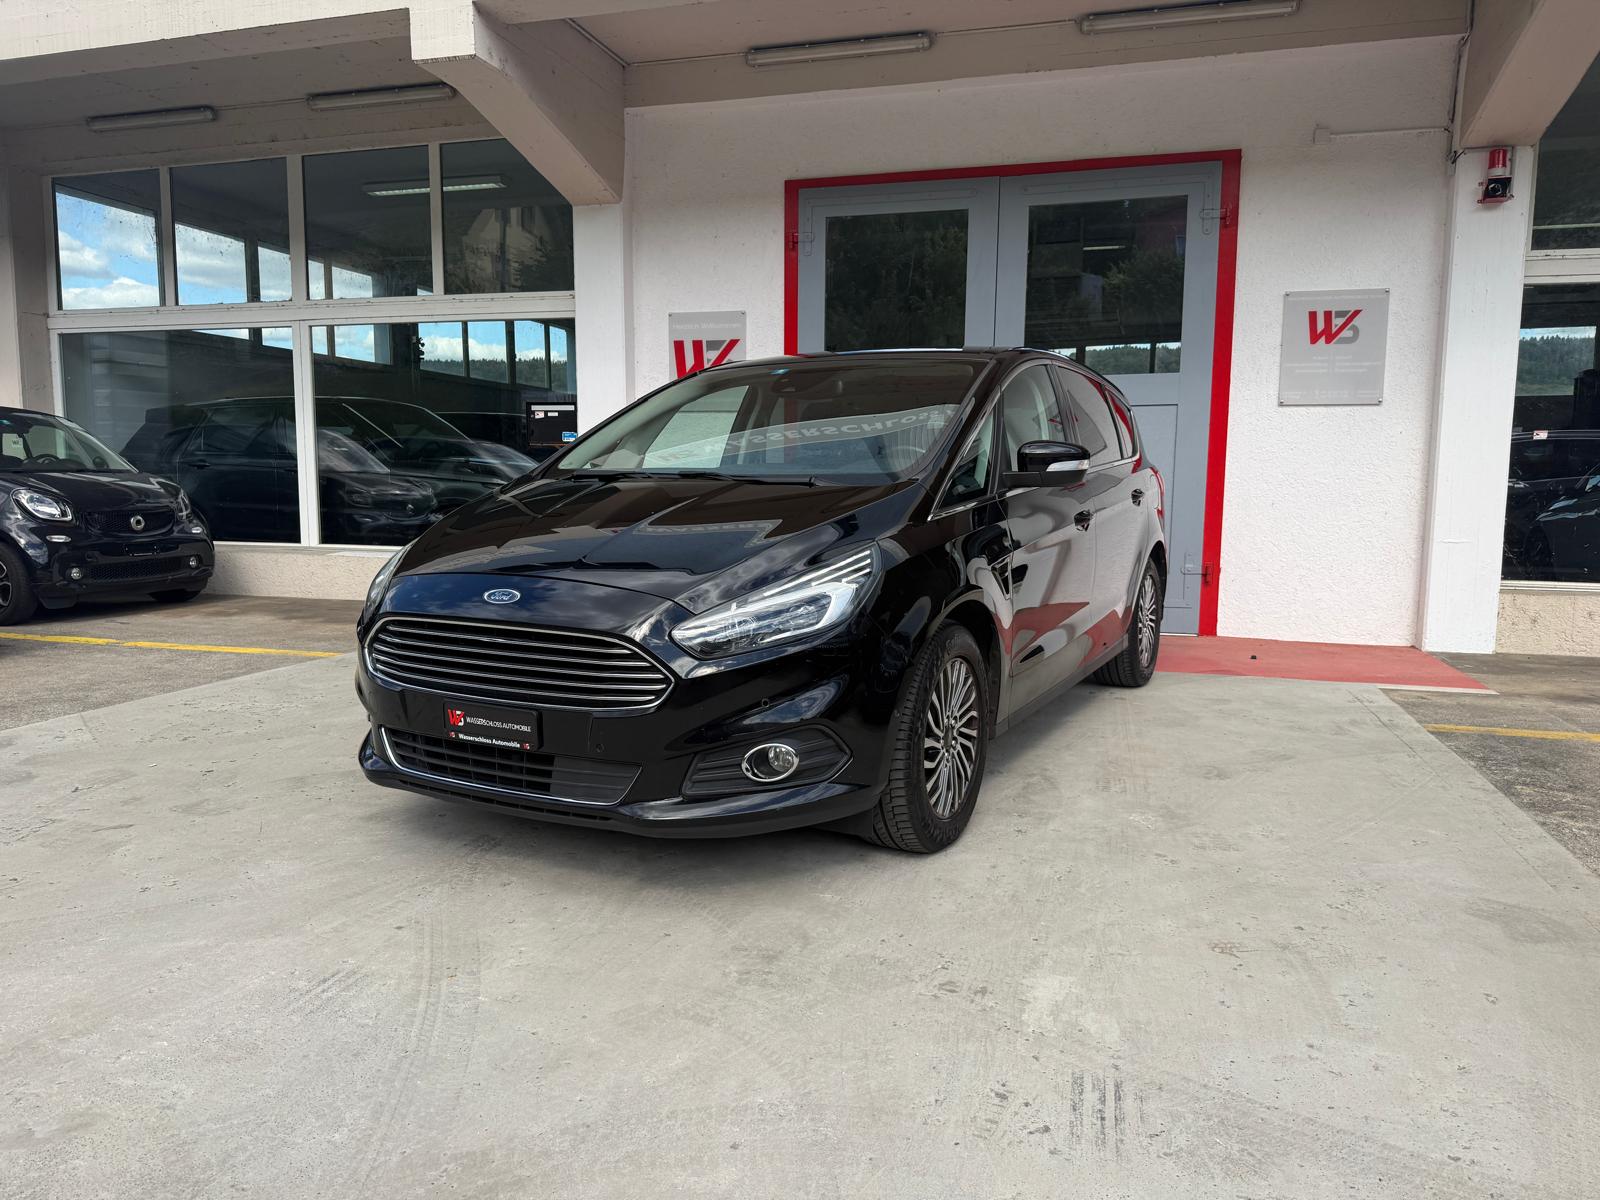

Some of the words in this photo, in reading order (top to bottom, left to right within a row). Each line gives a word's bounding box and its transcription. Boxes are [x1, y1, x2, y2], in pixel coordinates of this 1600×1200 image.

[466, 716, 502, 728] WASSERSCHLOSS
[502, 722, 532, 733] AUTOMOBILE
[458, 733, 492, 744] Wasserschloss
[492, 738, 521, 749] Automobile
